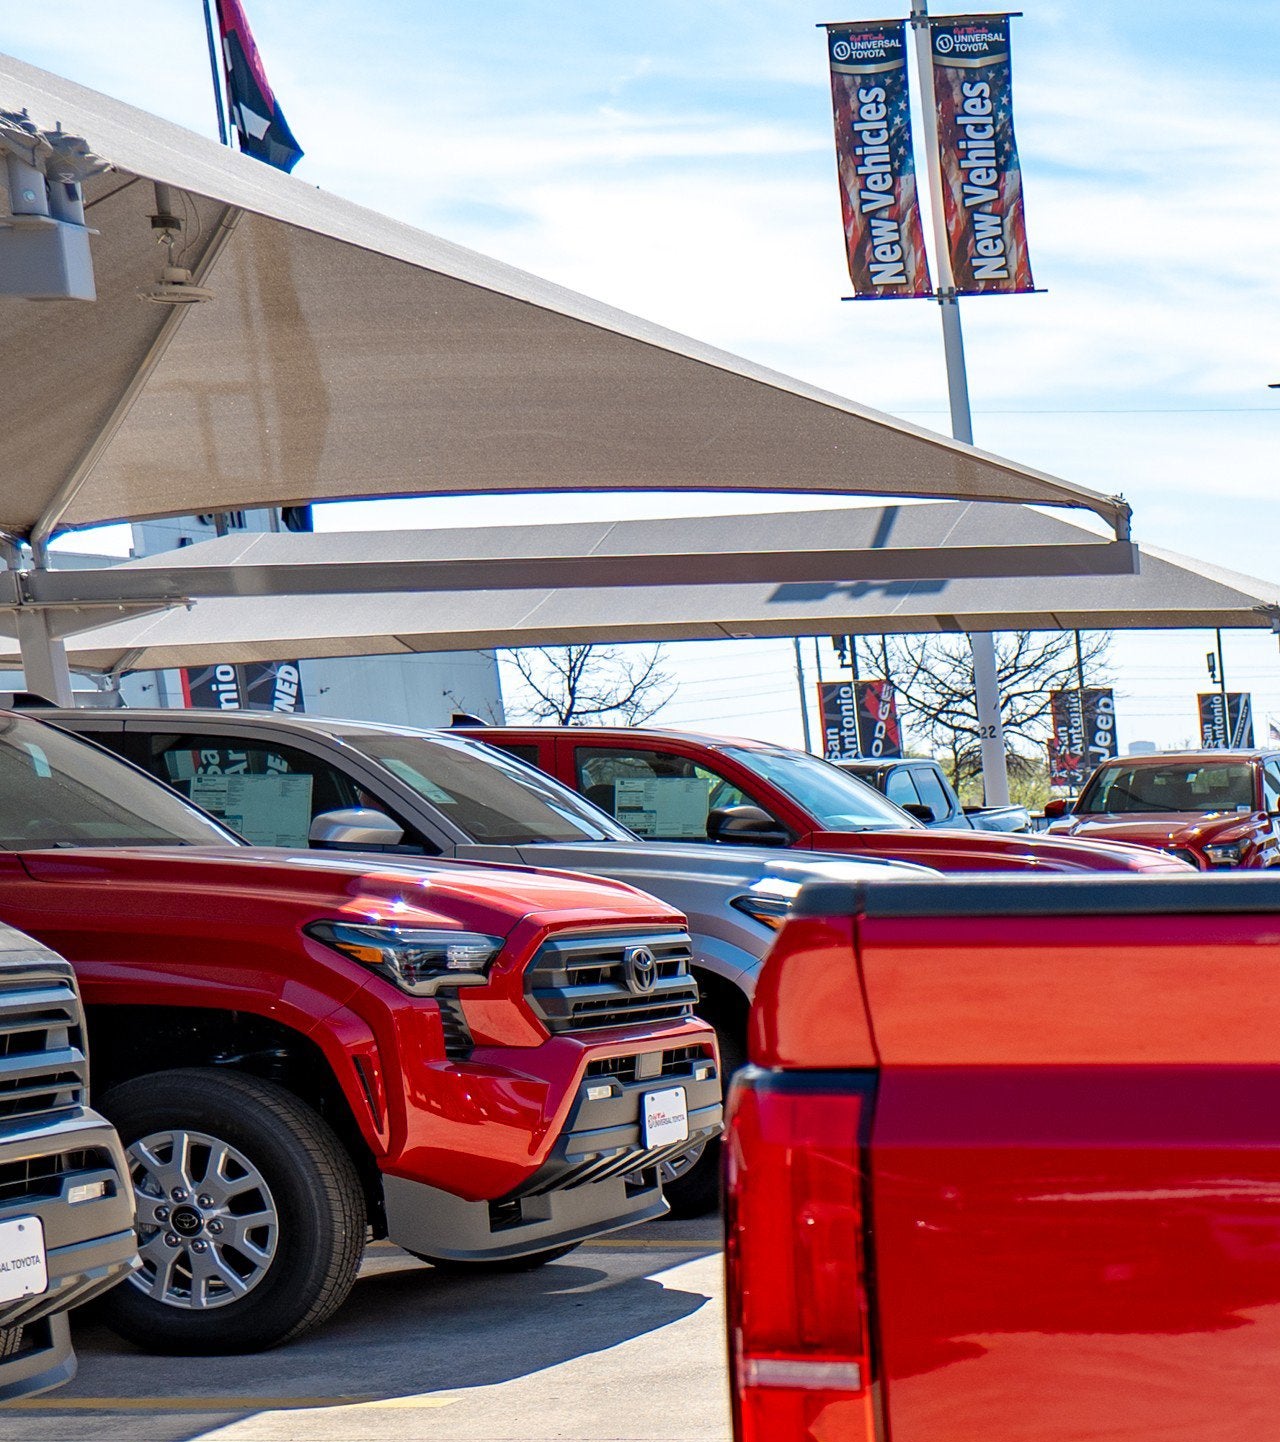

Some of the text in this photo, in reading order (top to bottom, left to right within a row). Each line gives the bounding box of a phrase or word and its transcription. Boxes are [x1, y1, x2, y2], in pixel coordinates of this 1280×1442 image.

[850, 38, 902, 50] UNIVERSAL
[953, 32, 1006, 43] UNIVERSAL
[851, 49, 886, 59] TOYOTA
[954, 42, 989, 52] TOYOTA
[853, 86, 908, 286] New Vehicles
[957, 82, 1010, 281] New Vehicles
[980, 725, 997, 739] 22
[1089, 696, 1114, 762] Jeep
[11, 1254, 41, 1270] TOYOTA
